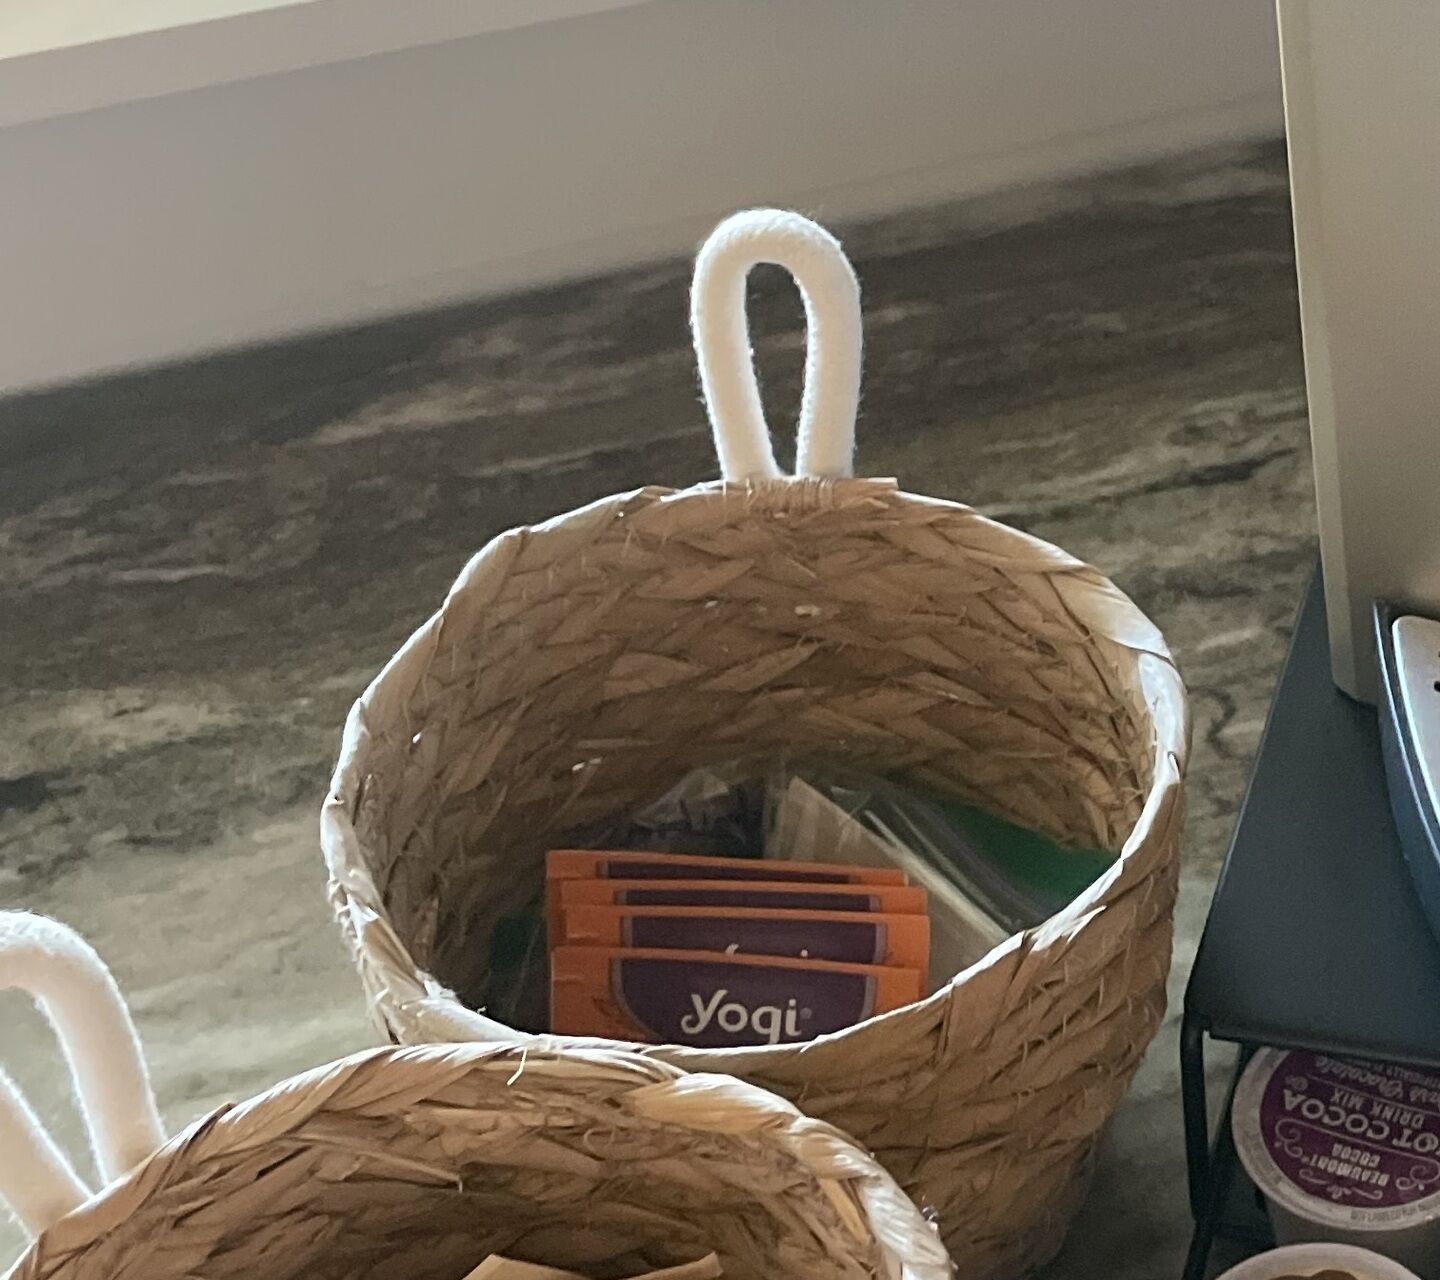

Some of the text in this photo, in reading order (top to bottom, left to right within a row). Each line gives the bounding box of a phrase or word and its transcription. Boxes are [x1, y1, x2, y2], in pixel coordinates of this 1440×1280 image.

[1283, 1088, 1390, 1140] COCOA
[1330, 1087, 1425, 1129] DRINK MIX
